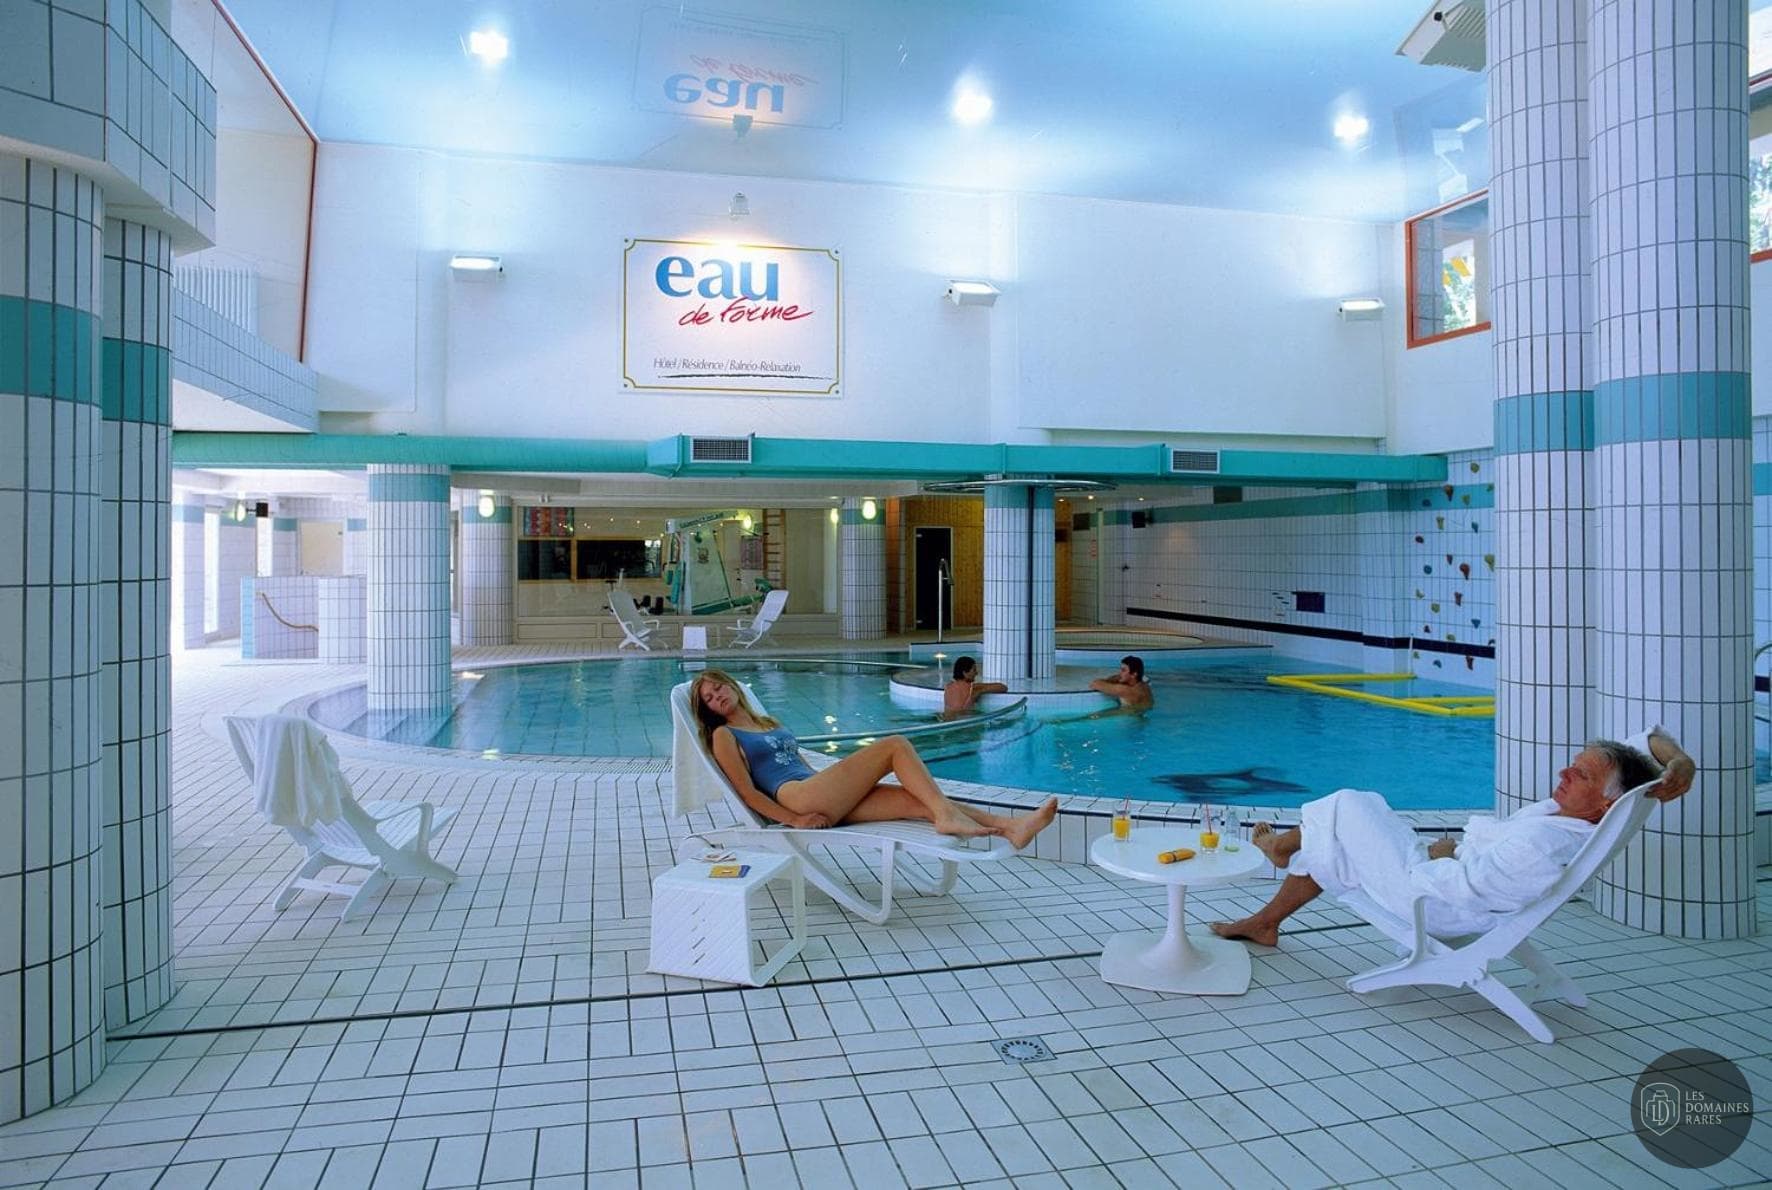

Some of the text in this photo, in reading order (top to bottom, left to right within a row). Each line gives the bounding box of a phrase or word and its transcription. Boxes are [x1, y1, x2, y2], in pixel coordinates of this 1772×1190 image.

[655, 255, 779, 302] eau
[678, 296, 814, 326] de forme
